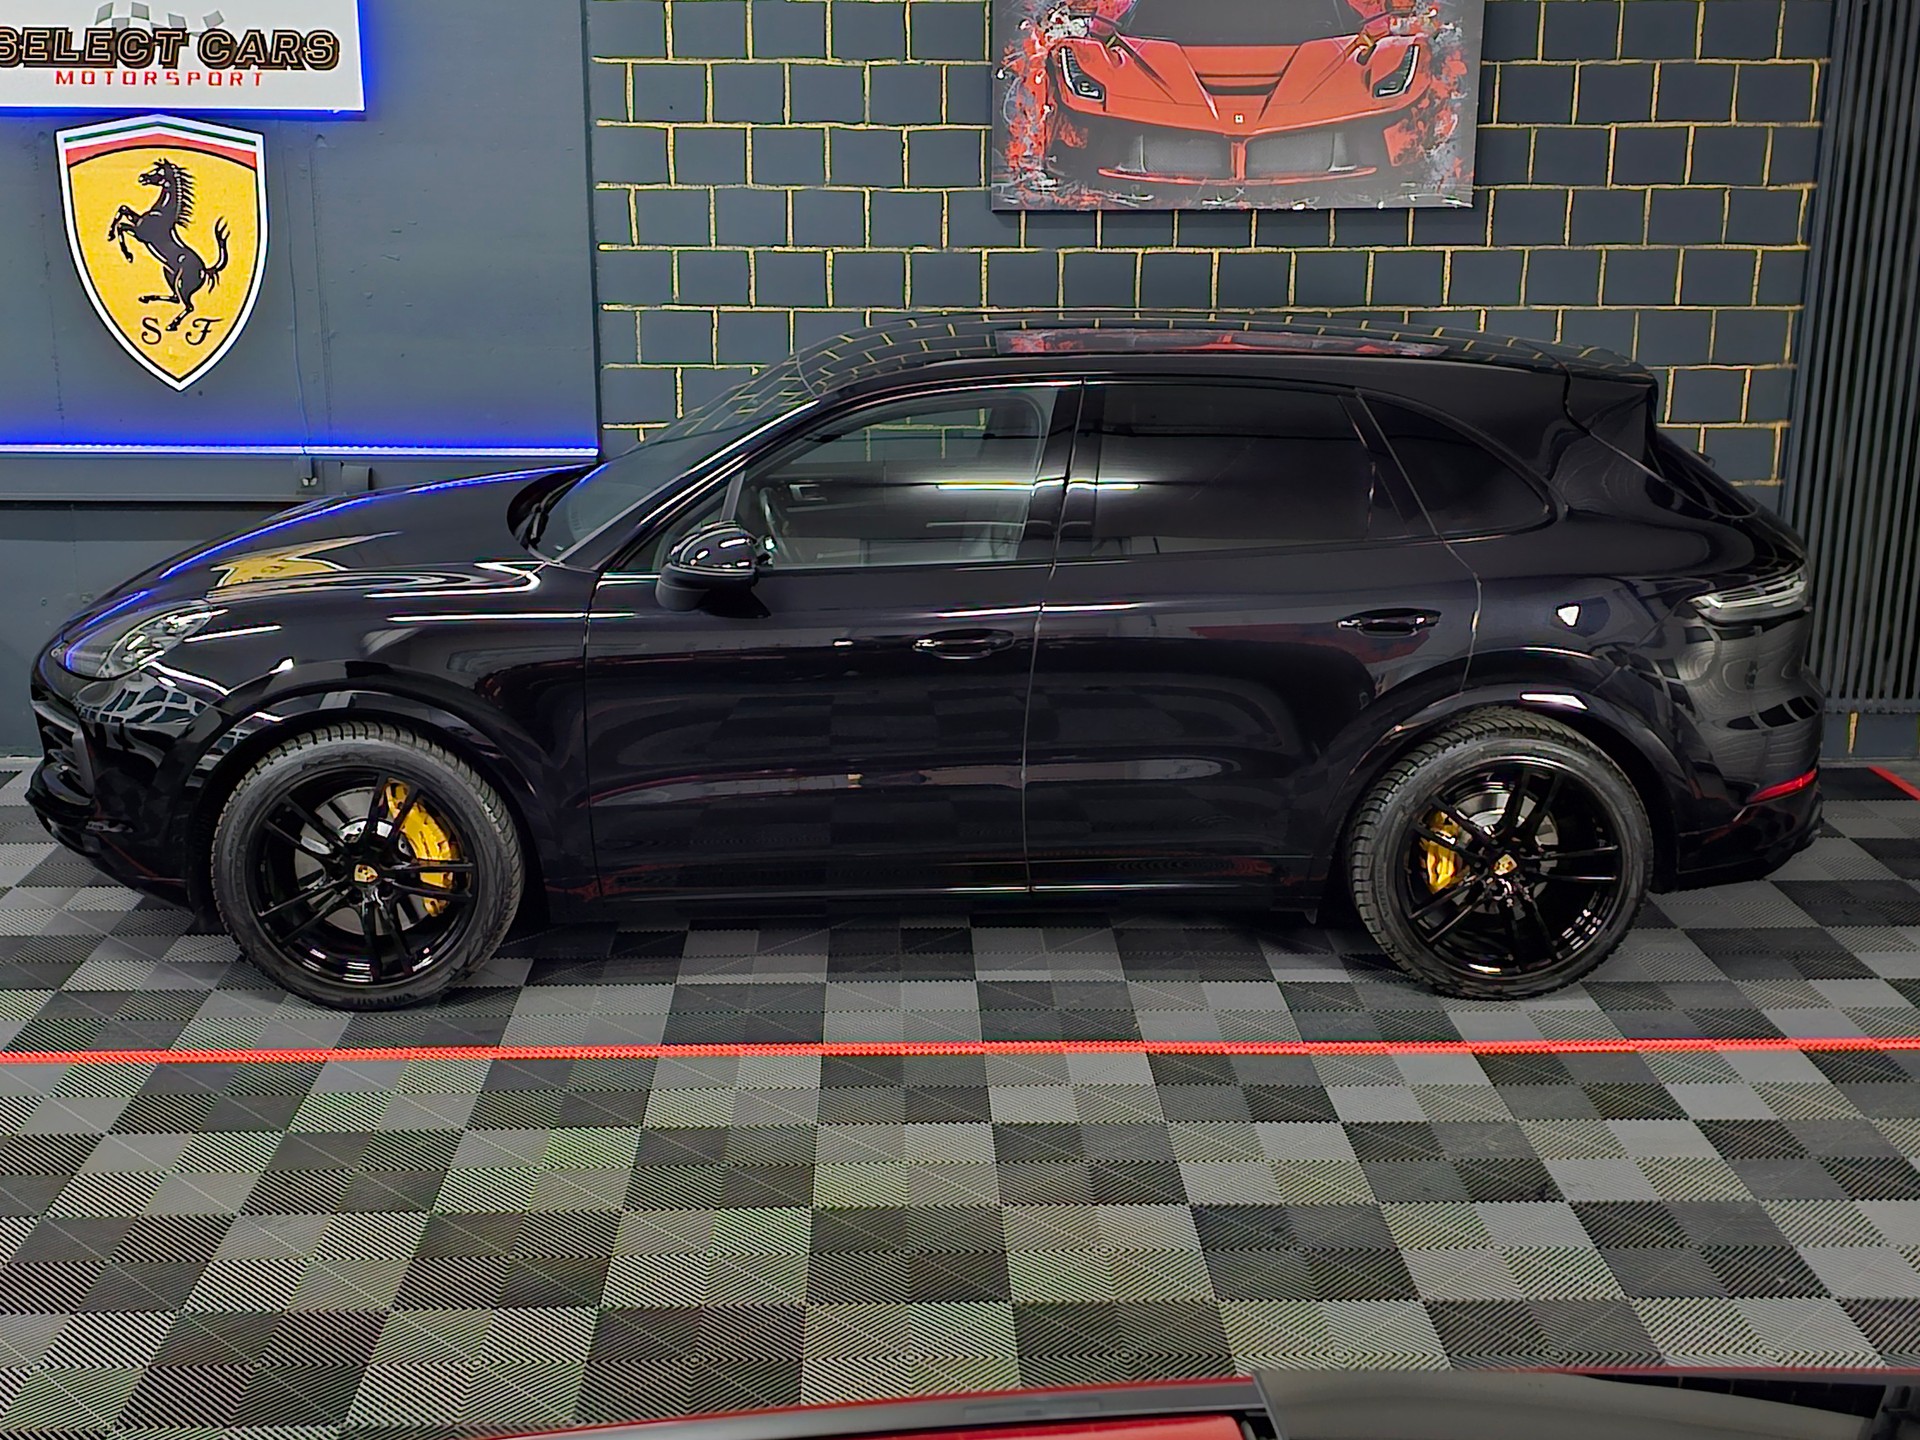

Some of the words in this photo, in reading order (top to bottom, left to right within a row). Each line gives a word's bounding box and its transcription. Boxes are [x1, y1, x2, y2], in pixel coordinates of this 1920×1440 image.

[0, 27, 189, 69] SELECT
[199, 29, 340, 70] CARS
[55, 70, 264, 87] MOTORSPORT
[141, 317, 163, 345] S
[185, 317, 224, 346] F
